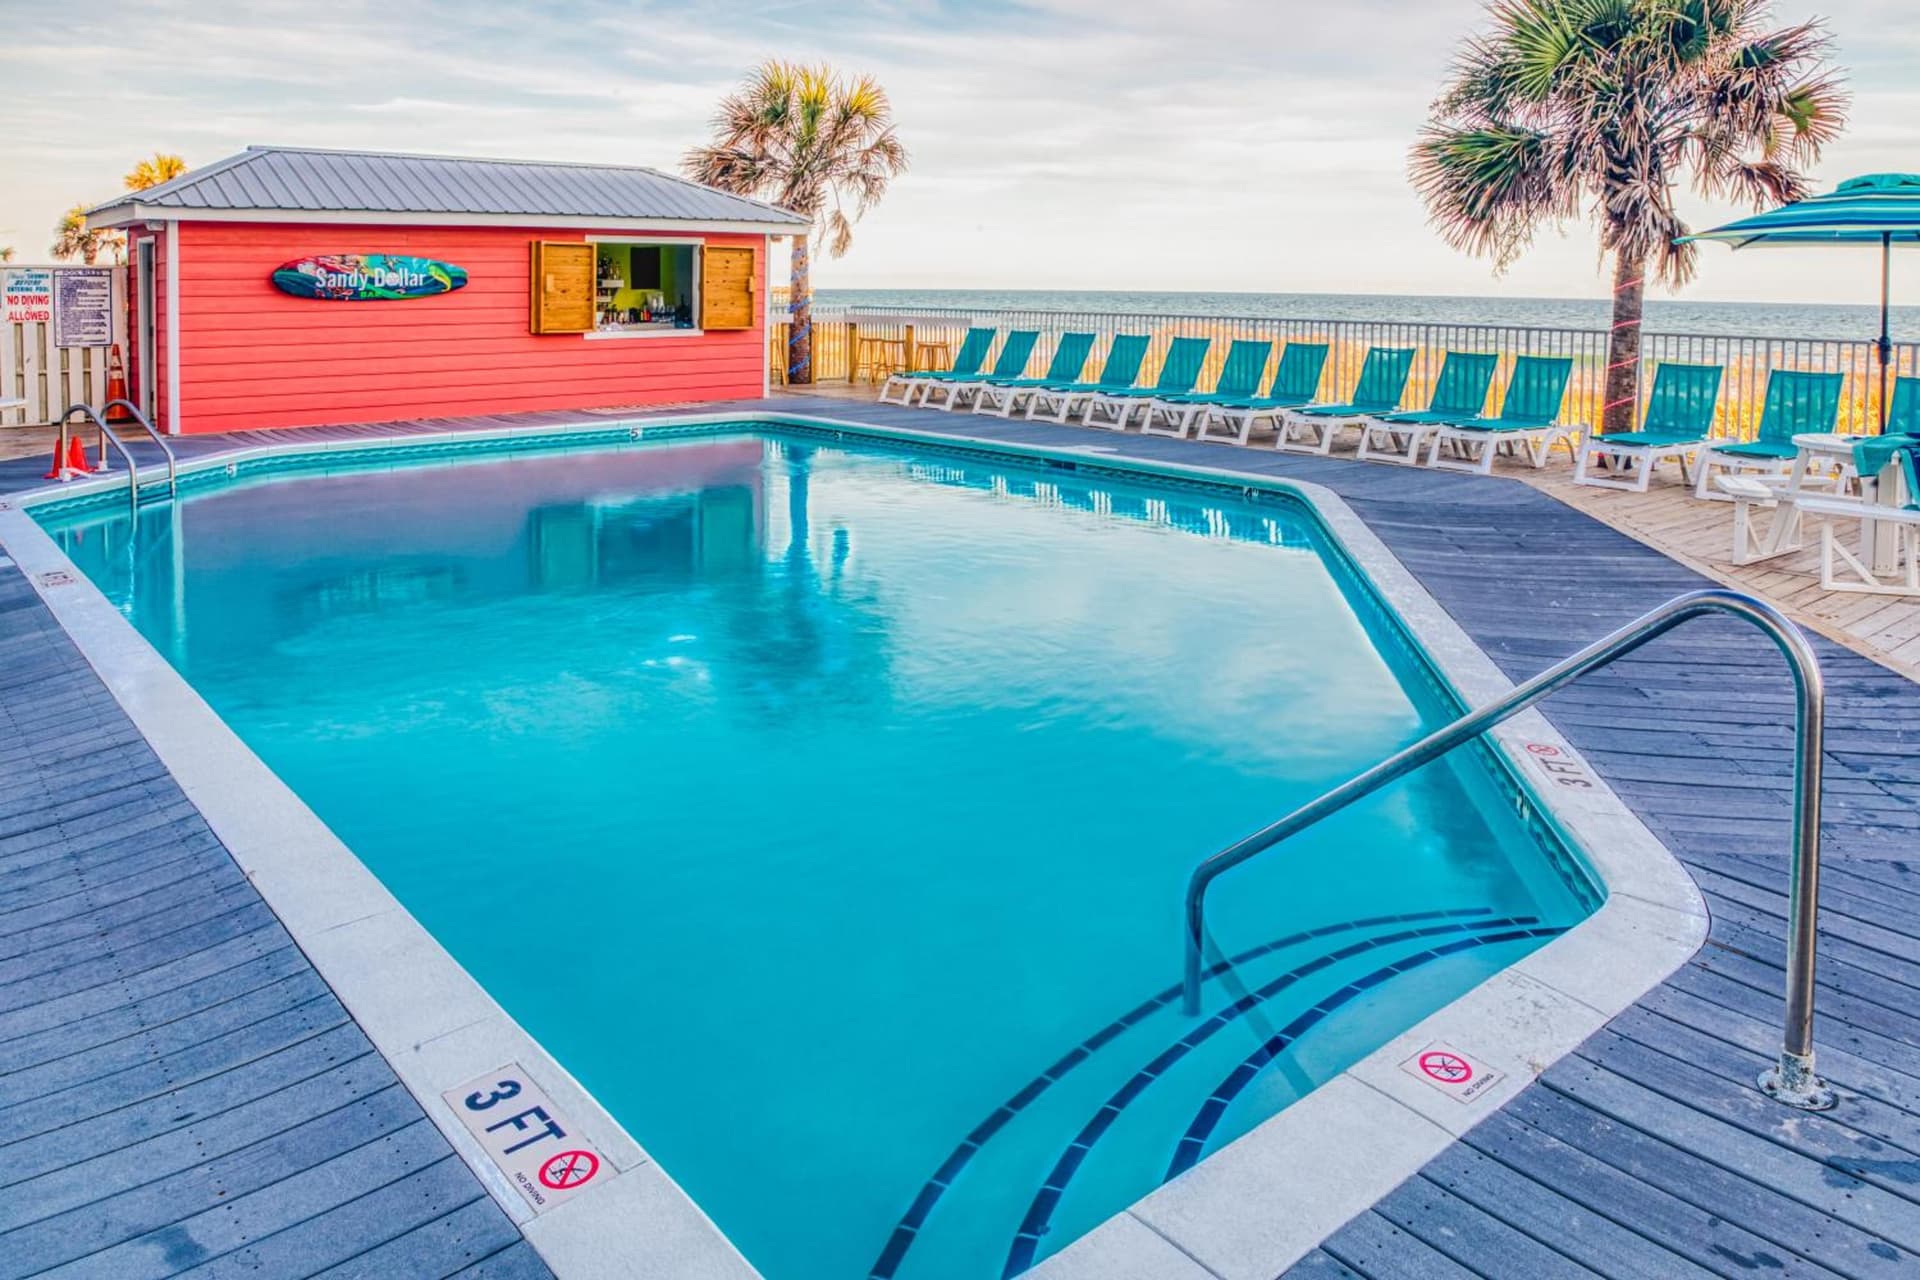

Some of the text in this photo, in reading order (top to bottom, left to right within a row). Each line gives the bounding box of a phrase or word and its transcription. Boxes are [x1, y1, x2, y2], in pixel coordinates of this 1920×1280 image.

[315, 267, 427, 289] Sandy Dollar
[7, 295, 49, 305] NO DIVING
[8, 310, 50, 321] ALLOWED
[1539, 757, 1593, 788] 3 FT
[1461, 1087, 1475, 1097] NO
[464, 1079, 568, 1156] 3 FT
[514, 1171, 546, 1206] NO DIVING
